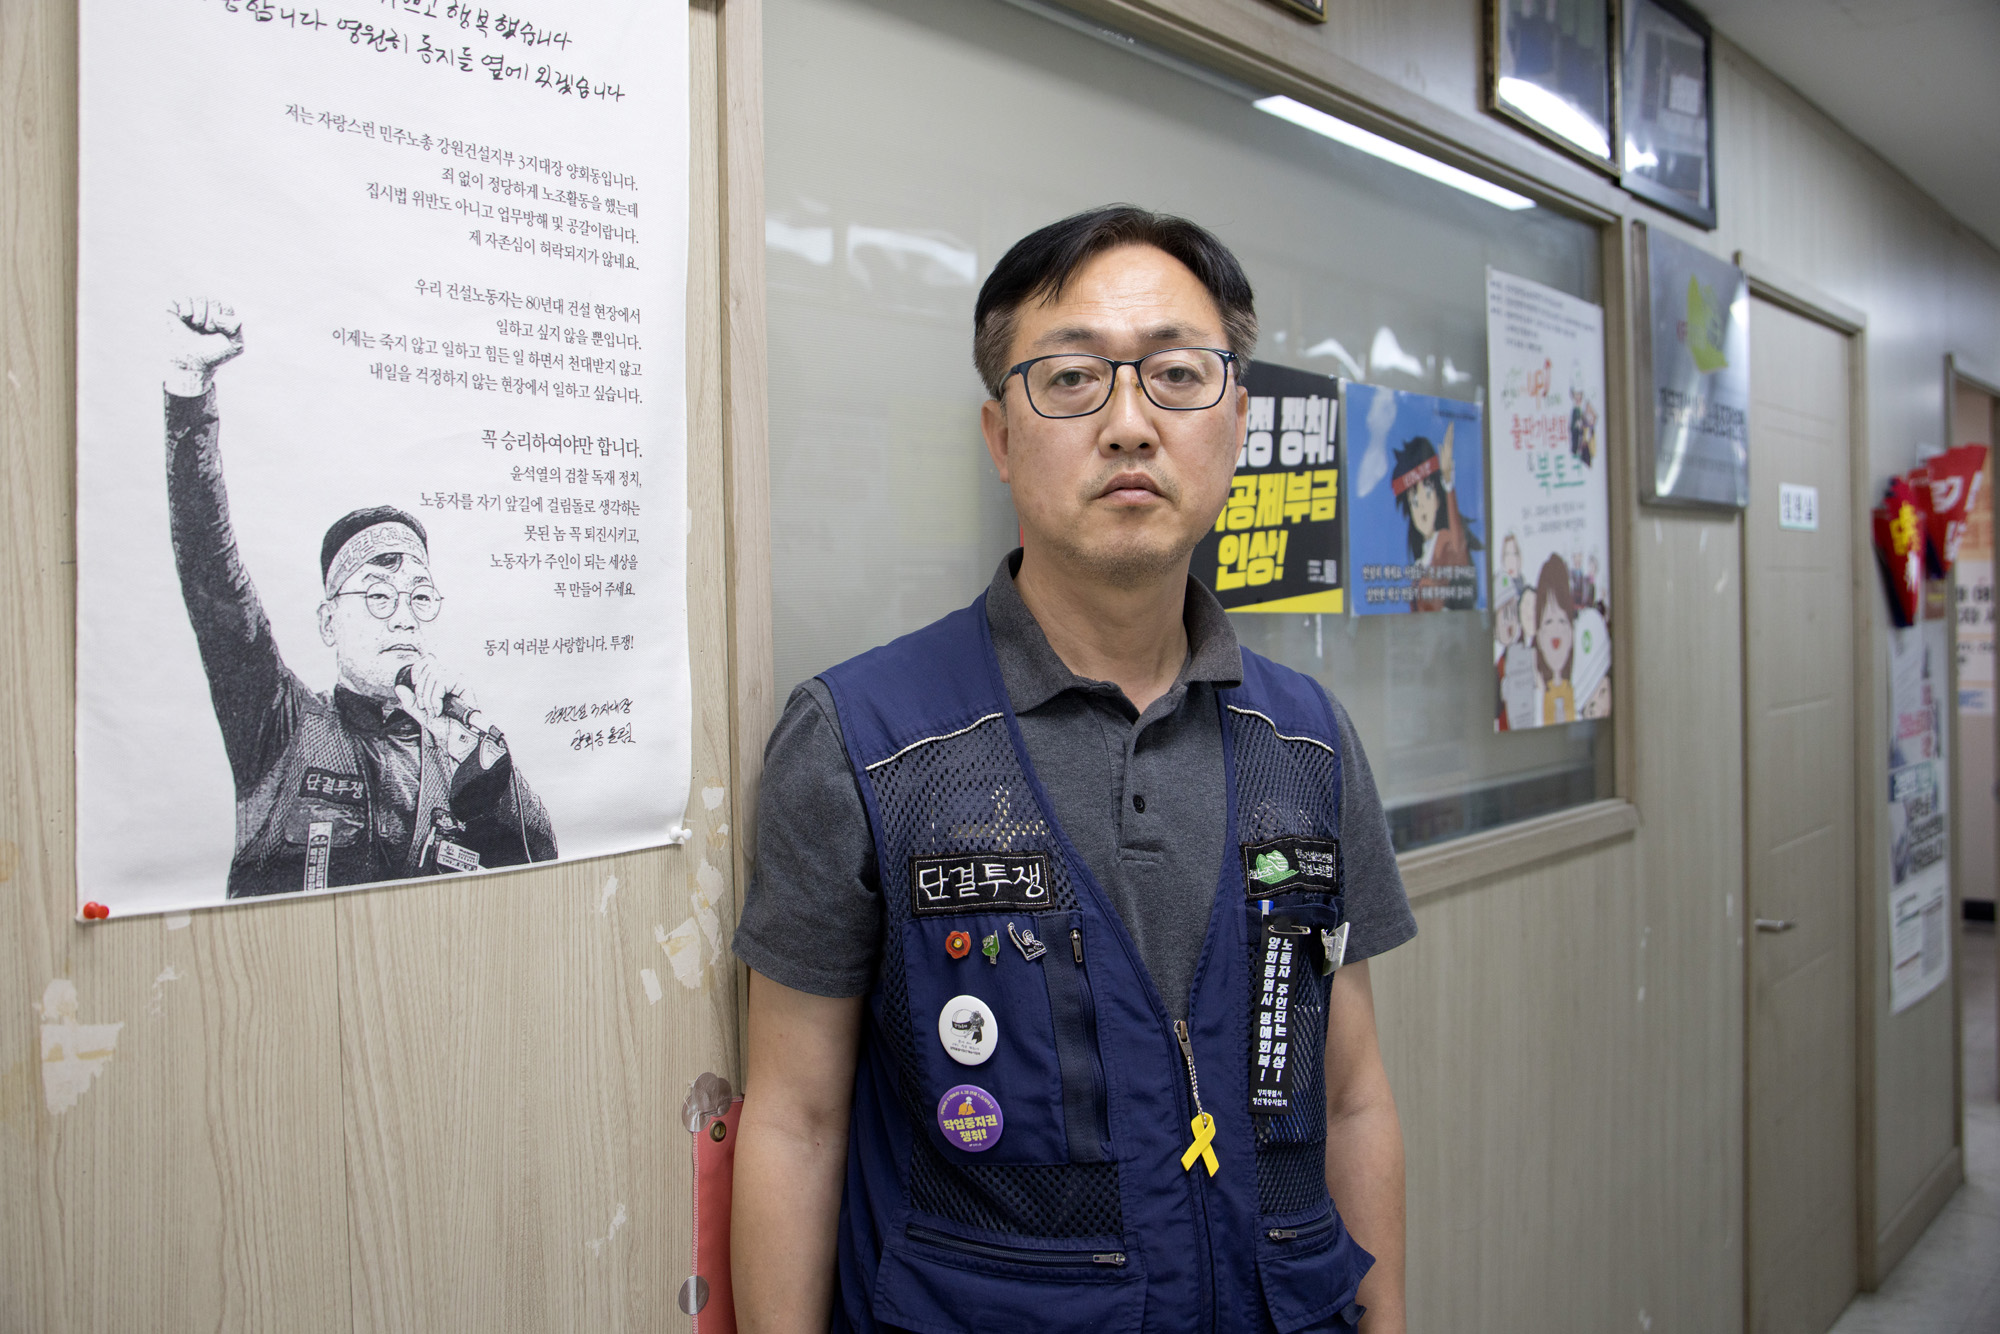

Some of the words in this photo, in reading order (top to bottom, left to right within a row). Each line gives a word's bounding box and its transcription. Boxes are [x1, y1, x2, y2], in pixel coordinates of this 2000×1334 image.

[380, 0, 437, 19] 쁘고
[337, 18, 409, 54] 영원히
[417, 34, 474, 72] 동지들
[481, 54, 529, 81] 옆에
[284, 103, 315, 126] 저는
[317, 111, 376, 139] 자랑스런
[379, 124, 435, 152] 민주노총
[436, 137, 516, 167] 강원건설지부
[518, 154, 564, 178] 3지대장
[565, 163, 639, 191] 양회동입니다.
[441, 166, 454, 185] 죄
[458, 170, 484, 190] 없이
[487, 176, 539, 200] 정당하게
[541, 186, 603, 212] 노조활동을
[604, 197, 639, 218] 했는데
[365, 181, 407, 205] 집시법
[411, 190, 453, 211] 위반도
[454, 198, 495, 219] 아니고
[497, 206, 549, 229] 업무방해
[551, 215, 564, 233] 및
[565, 218, 640, 244] 공갈이랍니다.
[468, 229, 482, 247] 제
[484, 231, 536, 255] 자존심이
[539, 240, 600, 265] 허락되지가
[601, 250, 640, 270] 않네요.
[414, 278, 442, 299] 우리
[446, 282, 524, 309] 건설노동자는
[525, 295, 564, 315] 80년대
[567, 300, 591, 319] 건설
[593, 303, 641, 324] 현장에서
[331, 327, 377, 349] 이제는
[378, 332, 408, 352] 죽지
[410, 336, 439, 355] 않고
[441, 340, 482, 359] 일하고
[484, 344, 511, 365] 힘든
[512, 348, 525, 367] 일
[527, 350, 564, 370] 하면서
[567, 354, 616, 375] 천대받지
[618, 360, 643, 378] 않고
[496, 318, 534, 337] 일하고
[536, 323, 561, 343] 싶지
[563, 327, 589, 346] 않을
[590, 330, 642, 351] 뿐입니다.
[369, 361, 413, 383] 내일을
[471, 372, 499, 392] 않는
[500, 375, 549, 397] 현장에서
[552, 381, 591, 399] 일하고
[593, 384, 643, 404] 싶습니다.
[480, 429, 498, 450] 꼭
[499, 430, 595, 456] 승리하여야만
[596, 436, 643, 459] 합니다.
[1279, 394, 1338, 467] 쟁취!
[509, 465, 562, 484] 윤석열의
[564, 467, 590, 485] 검찰
[591, 468, 616, 486] 독재
[618, 469, 643, 489] 정치,
[1535, 451, 1587, 497] 북토크
[419, 491, 474, 511] 노동자를
[476, 493, 502, 512] 자기
[504, 495, 544, 513] 앞길에
[546, 496, 597, 515] 걸림돌로
[597, 498, 641, 517] 생각하는
[1215, 469, 1338, 533] 공제부금
[523, 524, 551, 542] 못된
[552, 525, 567, 542] 놈
[568, 526, 582, 543] 꼭
[583, 525, 640, 544] 퇴진시키고,
[489, 552, 543, 571] 노동자가
[544, 552, 581, 571] 주인이
[583, 553, 607, 571] 되는
[607, 553, 639, 571] 세상을
[1215, 530, 1289, 592] 인상!
[553, 581, 567, 598] 꼭
[568, 580, 603, 598] 만들어
[483, 638, 510, 657] 동지
[512, 637, 550, 656] 여러분
[551, 634, 608, 656] 사랑합니다.
[609, 633, 634, 652] 투쟁!
[570, 729, 604, 751] 양회동
[306, 773, 364, 799] 단결투쟁
[919, 862, 1045, 901] 단결투쟁
[1260, 936, 1281, 1006] 양회동열사
[1277, 938, 1293, 978] 노동자
[1273, 983, 1289, 1037] 주인되는
[1257, 1011, 1272, 1082] 명예회복!
[1272, 1042, 1288, 1082] 세상!
[1257, 1089, 1282, 1098] 양회동열사
[943, 1114, 998, 1131] 작업중지권
[959, 1128, 987, 1142] 쟁취!
